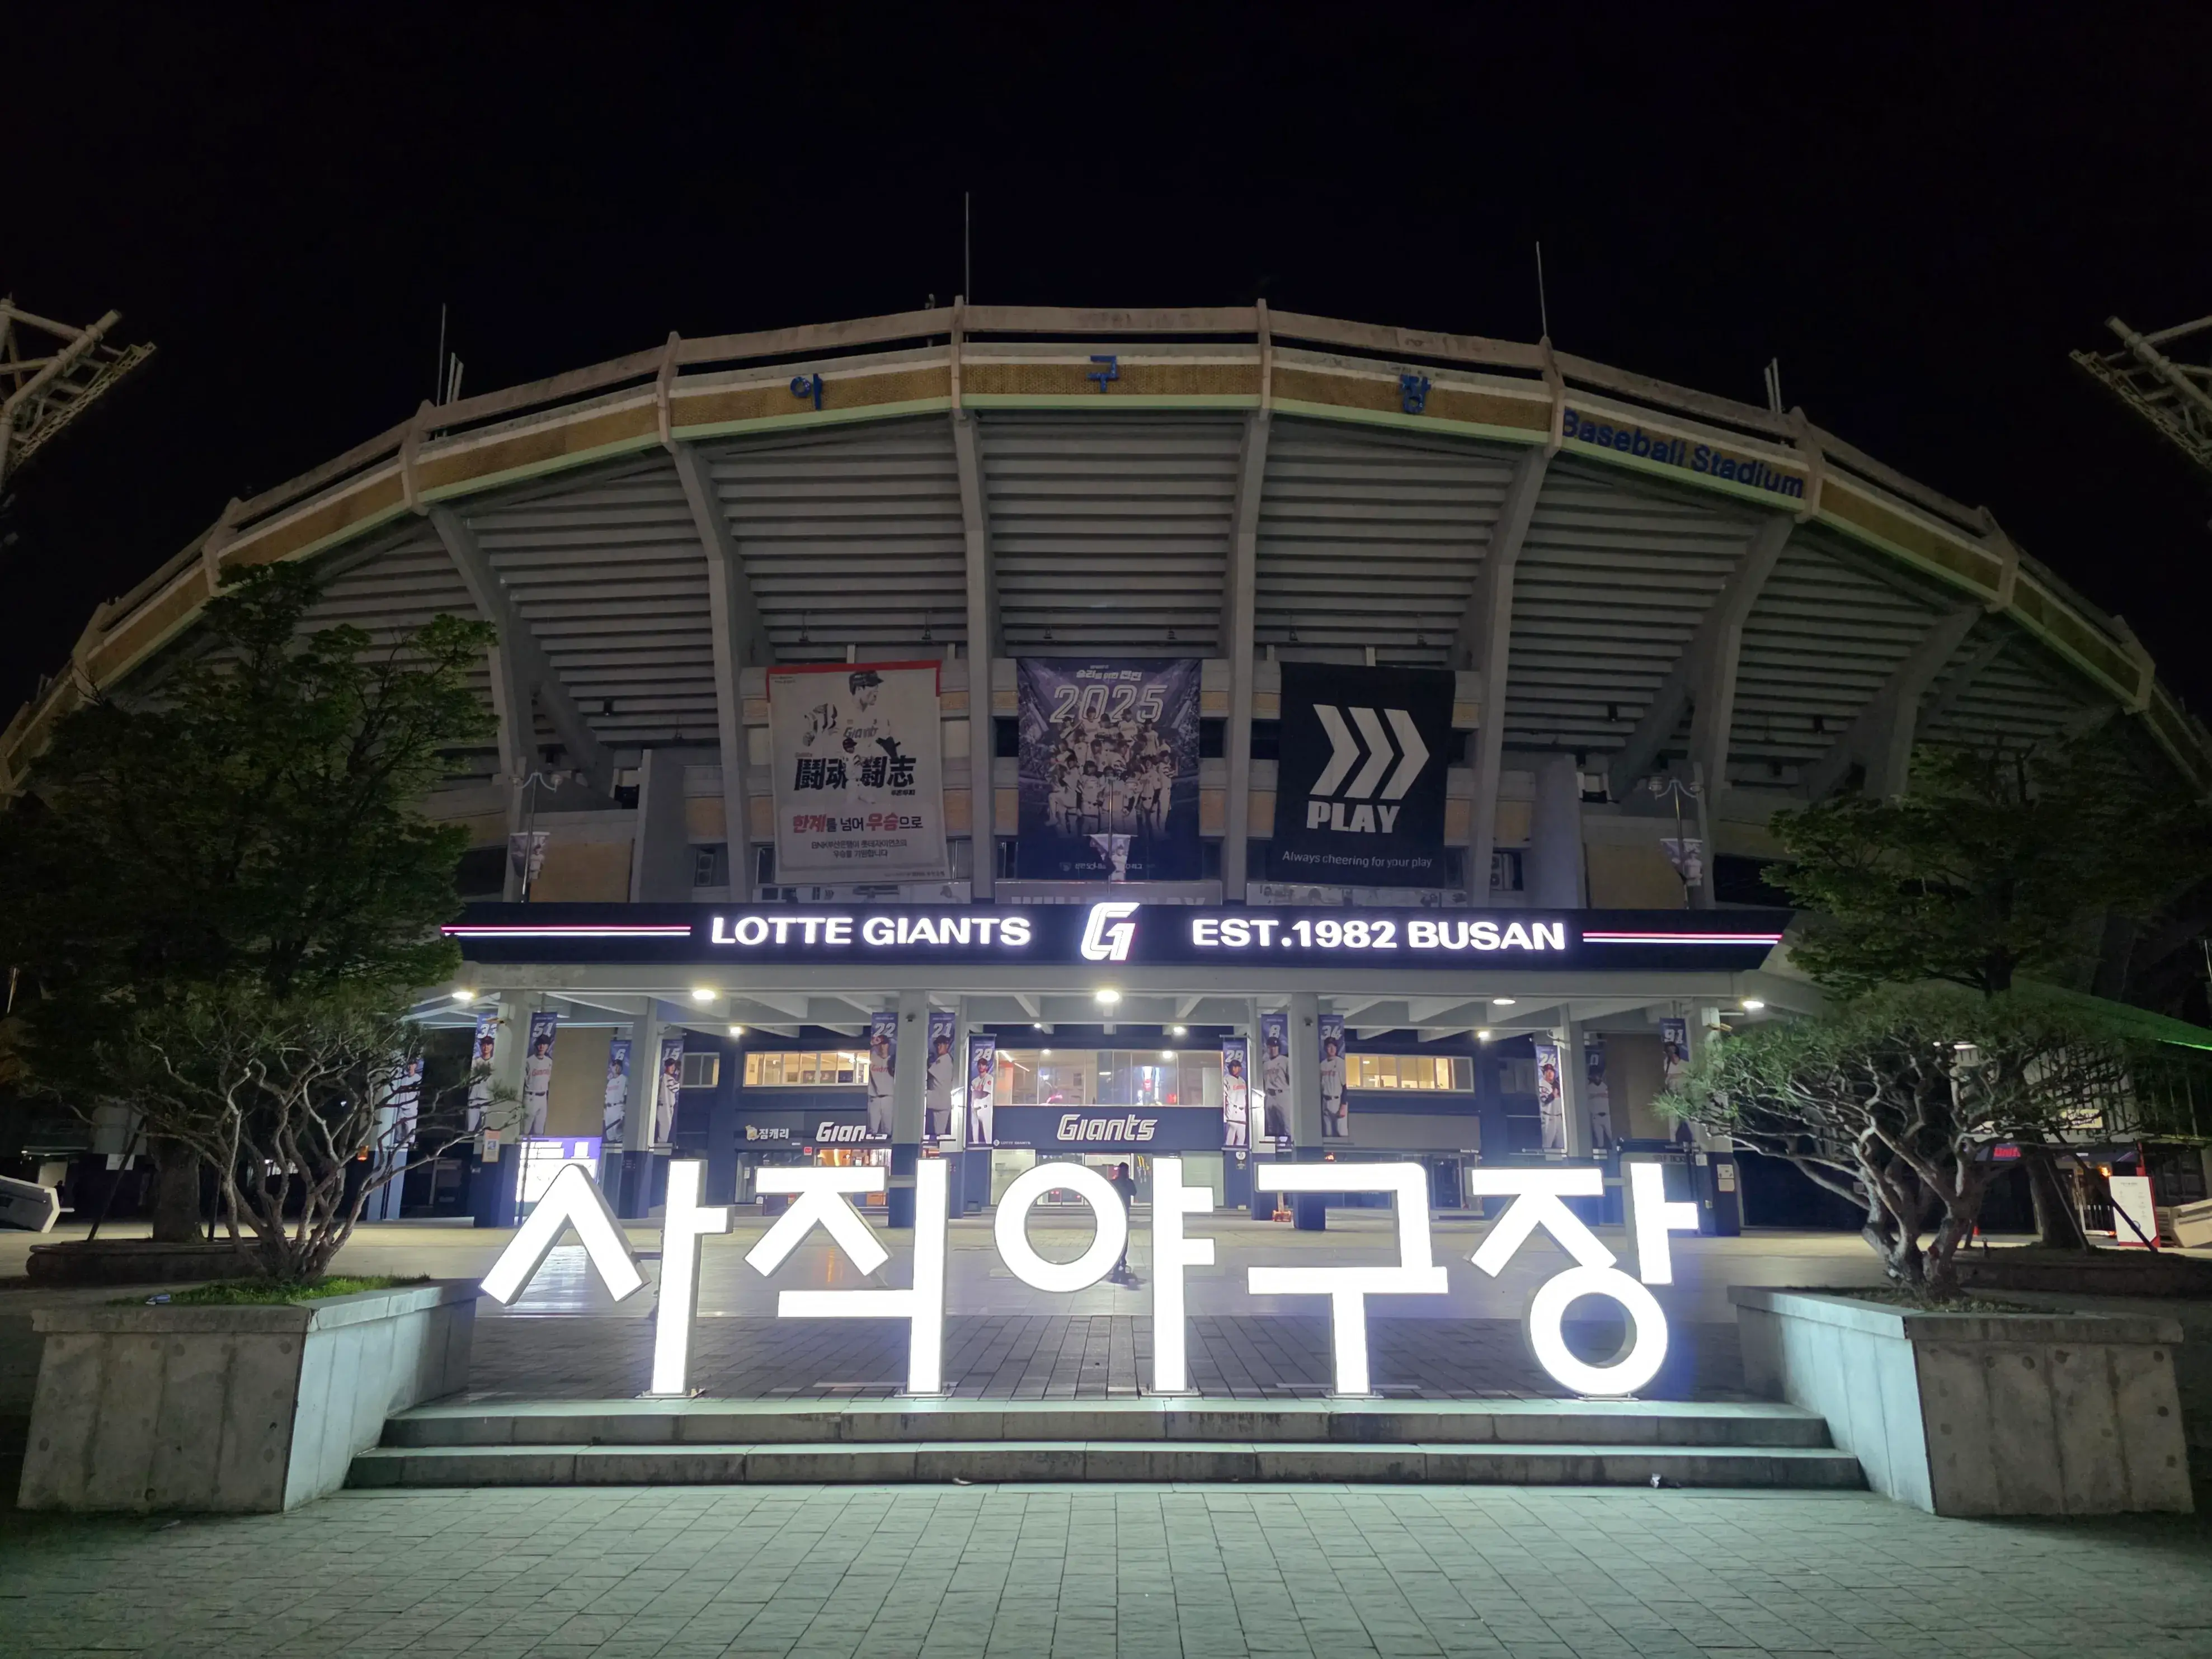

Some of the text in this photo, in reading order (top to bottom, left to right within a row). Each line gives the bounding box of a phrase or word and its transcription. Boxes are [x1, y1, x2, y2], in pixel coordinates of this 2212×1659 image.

[1087, 355, 1118, 393] 구
[1399, 374, 1431, 414] 장
[1562, 407, 1804, 498] Baseball Stadium
[1049, 684, 1168, 723] 2025
[792, 812, 924, 833] 한계를 넘어 우승으로
[1306, 799, 1401, 834] PLAY
[1282, 850, 1433, 869] Always cheering for your play
[711, 917, 853, 945] LOTTE
[863, 917, 1032, 946] GIANTS
[1192, 918, 1398, 949] EST.1982
[1408, 921, 1566, 951] BUSAN
[477, 1024, 497, 1039] 33
[533, 1022, 553, 1038] 51
[873, 1023, 896, 1038] 22
[931, 1023, 952, 1038] 21
[1269, 1025, 1281, 1039] 8
[1321, 1025, 1343, 1040] 34
[1664, 1029, 1684, 1044] 91
[615, 1049, 627, 1061] 6
[663, 1048, 681, 1061] 15
[973, 1048, 994, 1062] 28
[1225, 1050, 1245, 1063] 29
[1538, 1053, 1557, 1067] 24
[759, 1128, 789, 1140] 짐캐리
[816, 1121, 888, 1142] Gian
[1056, 1113, 1158, 1142] Giants
[479, 1158, 1700, 1397] 사직야구장
